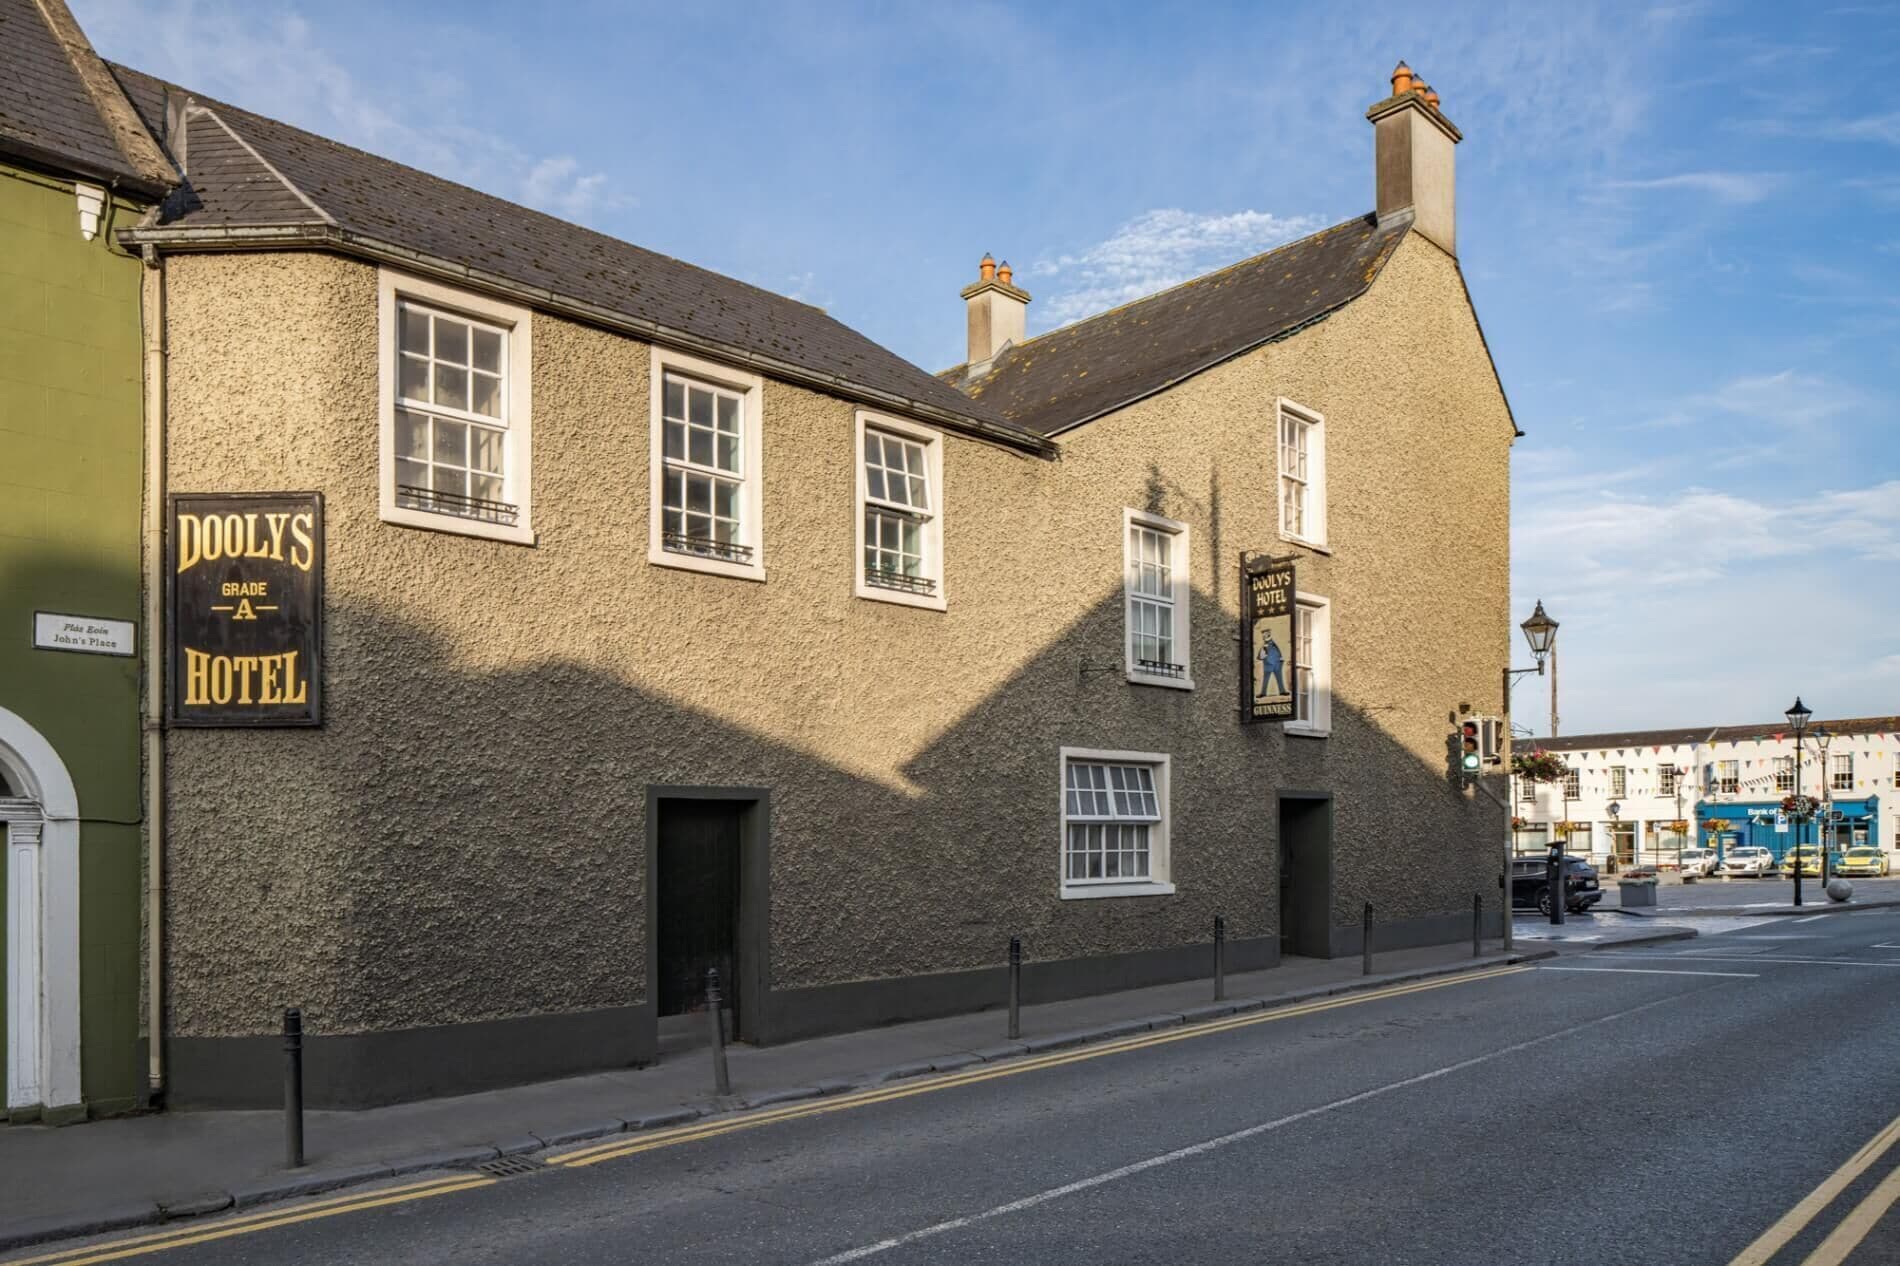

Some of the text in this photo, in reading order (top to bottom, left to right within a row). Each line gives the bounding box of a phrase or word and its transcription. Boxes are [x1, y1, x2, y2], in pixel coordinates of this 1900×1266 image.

[177, 512, 313, 574] DOOLYS
[221, 581, 268, 597] GRADE
[1256, 589, 1287, 607] HOTEL
[232, 599, 257, 620] A
[86, 625, 109, 635] Eoin
[53, 634, 117, 648] John's Place
[184, 647, 307, 706] HOTEL
[1254, 704, 1291, 716] GUINNESS
[1778, 815, 1786, 824] P
